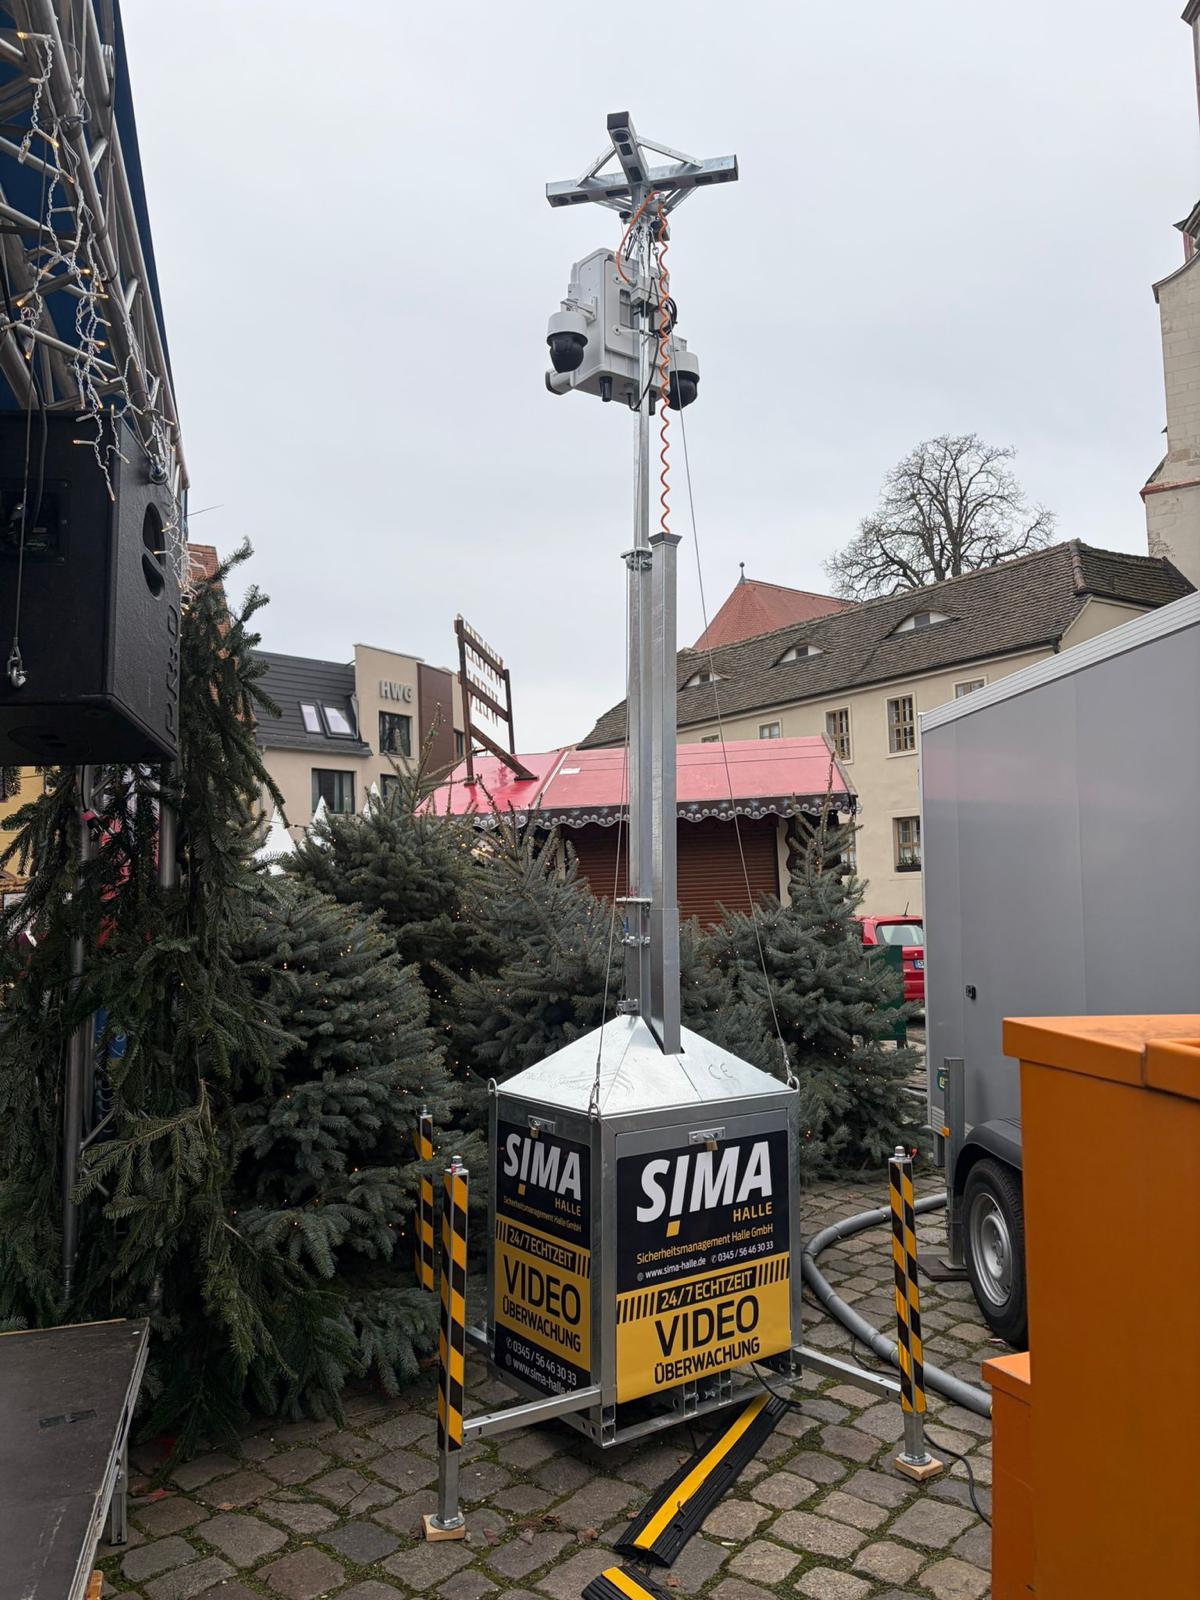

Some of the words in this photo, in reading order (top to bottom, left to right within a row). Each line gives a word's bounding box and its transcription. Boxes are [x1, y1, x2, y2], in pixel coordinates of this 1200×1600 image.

[379, 680, 415, 704] HWG
[504, 1133, 581, 1201] SIMA
[637, 1141, 772, 1223] SIMA
[555, 1198, 581, 1216] HALLE
[733, 1202, 773, 1223] HALLE
[530, 1238, 574, 1268] ECHTZEIT
[637, 1235, 730, 1265] Sicherheitsmanagement
[731, 1229, 750, 1243] Halle
[751, 1223, 773, 1238] GmbH
[645, 1257, 707, 1279] www.sima-halle.de
[717, 1250, 734, 1262] 0345
[739, 1247, 748, 1257] 56
[748, 1245, 757, 1254] 46
[757, 1242, 766, 1252] 30
[766, 1240, 774, 1250] 33
[503, 1254, 581, 1325] VIDEO
[695, 1270, 753, 1301] ECHTZEIT
[503, 1294, 581, 1353] ÜBERWACHUNG
[655, 1295, 759, 1357] VIDEO
[513, 1341, 530, 1359] 0345
[535, 1354, 545, 1368] 56
[545, 1359, 555, 1374] 46
[556, 1365, 566, 1380] 30
[567, 1371, 577, 1386] 33
[654, 1337, 760, 1385] ÜBERWACHUNG
